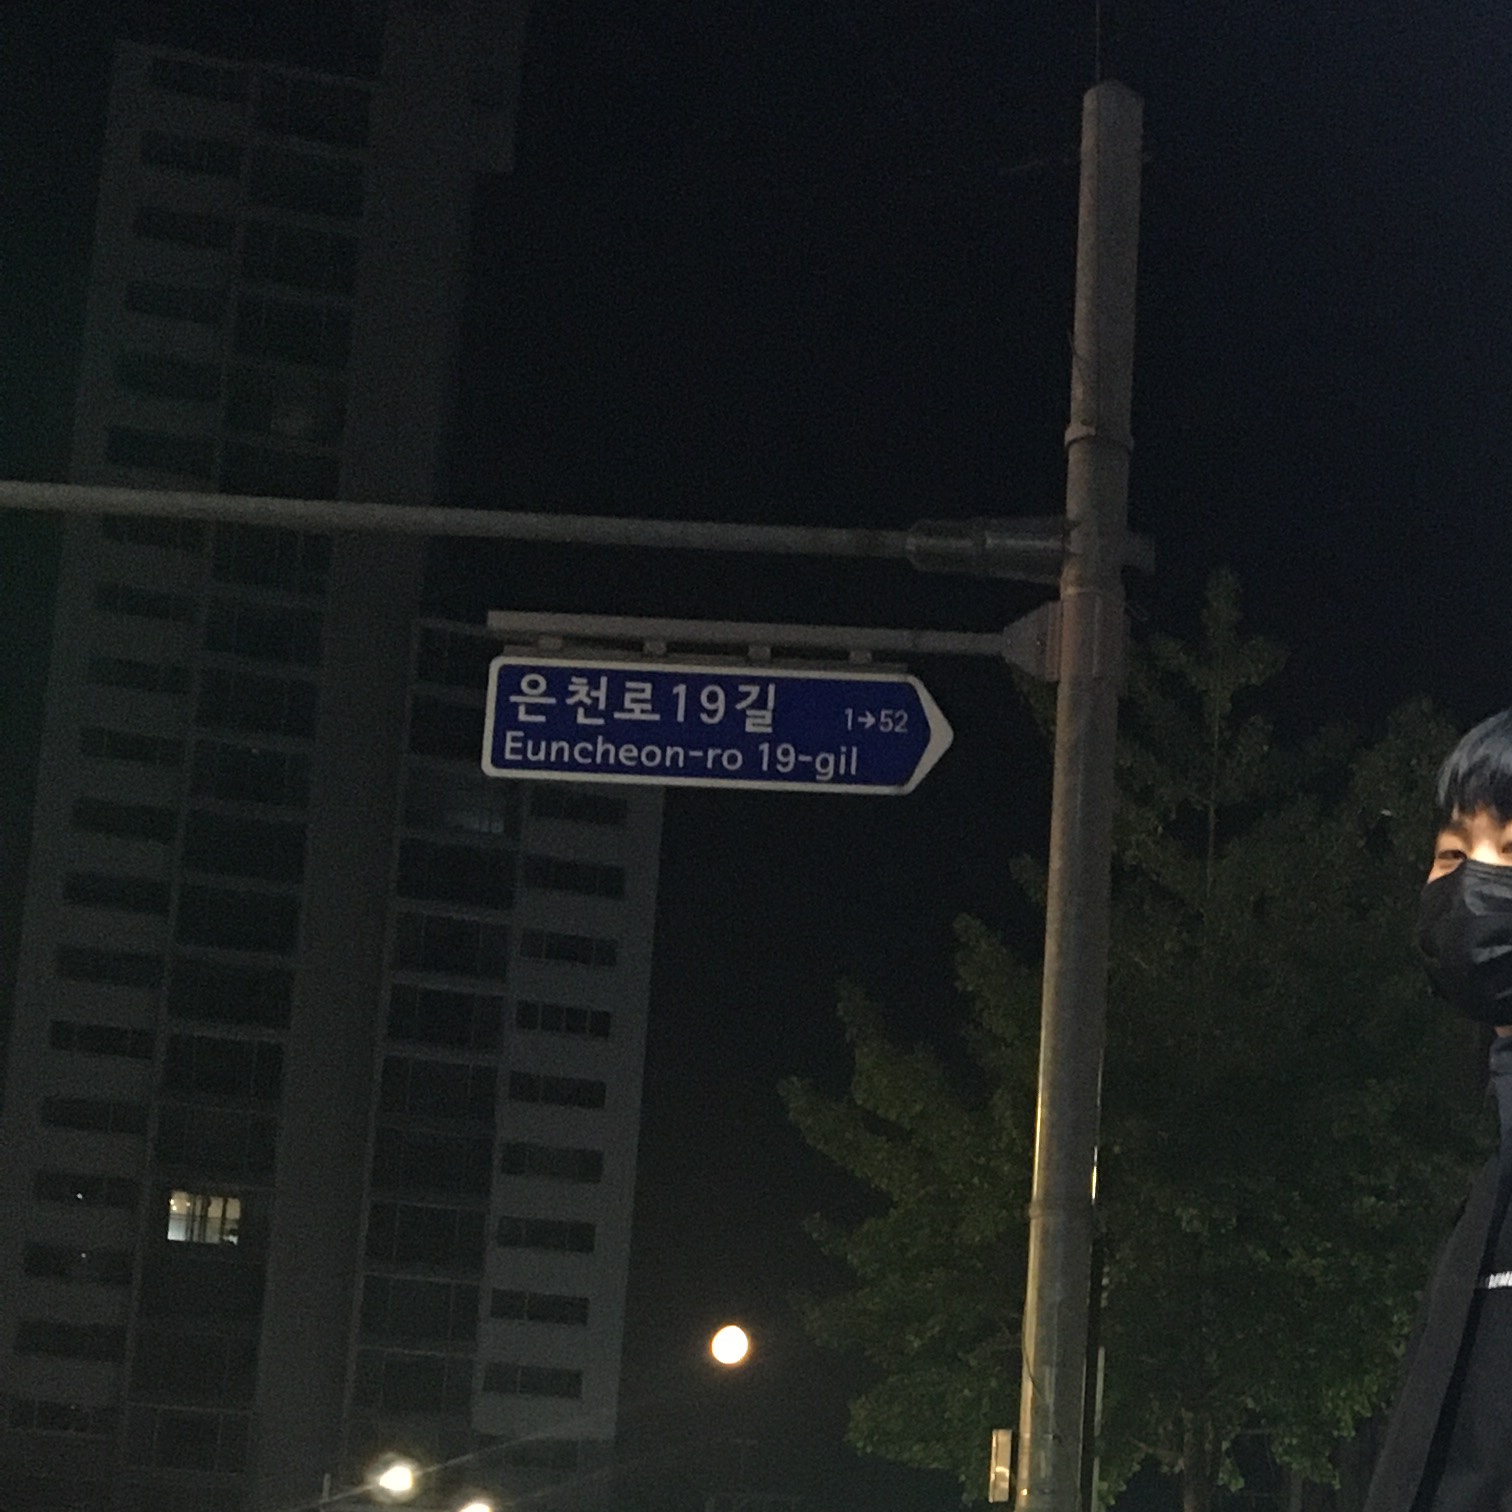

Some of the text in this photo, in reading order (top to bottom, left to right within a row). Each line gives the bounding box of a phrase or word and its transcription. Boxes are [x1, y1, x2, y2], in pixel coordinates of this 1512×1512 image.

[509, 672, 777, 733] 은천로19길
[504, 731, 858, 781] Euncheon-ro 19-gil
